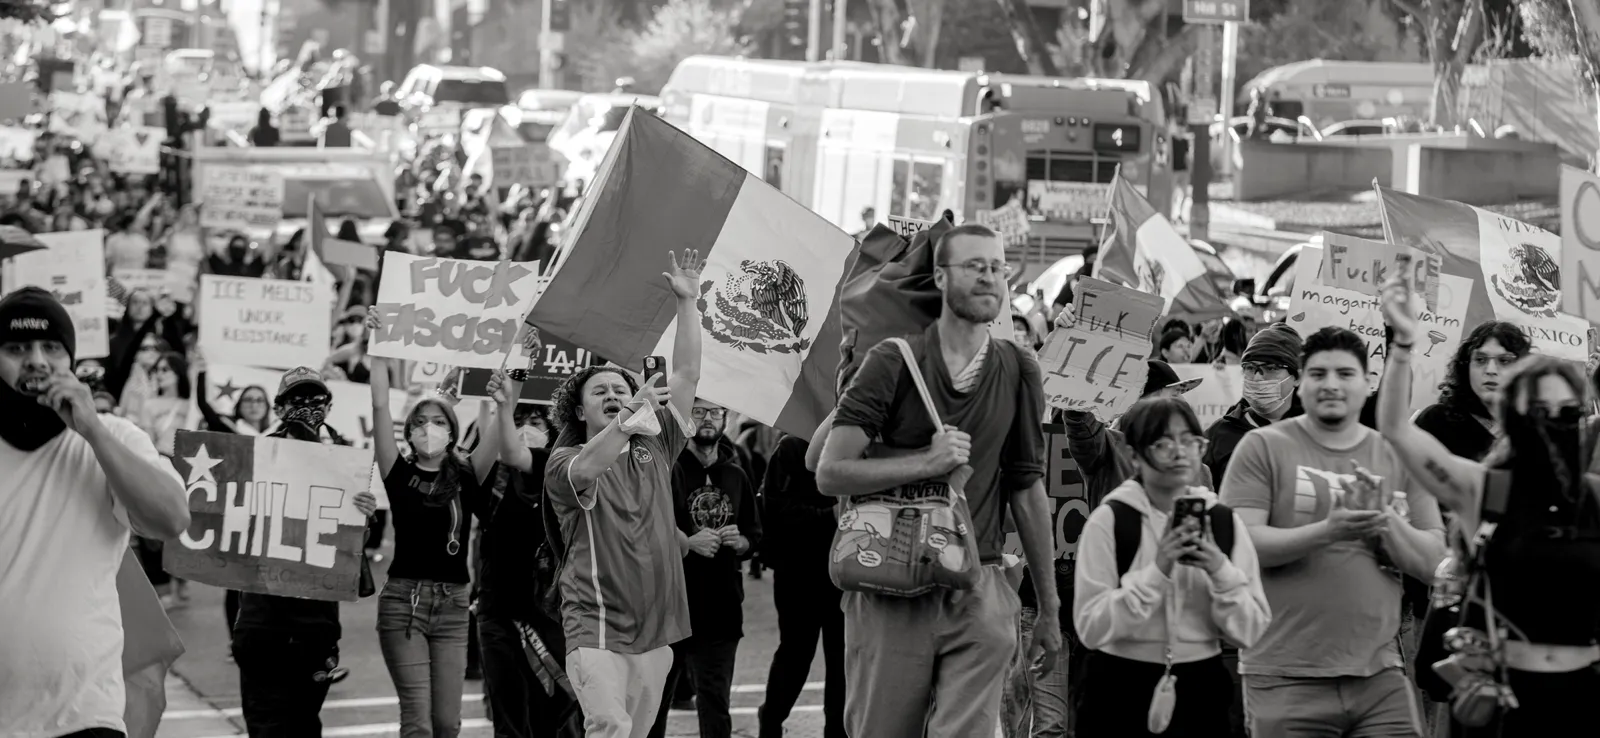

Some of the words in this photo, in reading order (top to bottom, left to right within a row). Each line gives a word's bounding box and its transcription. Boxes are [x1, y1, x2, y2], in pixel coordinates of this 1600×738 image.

[1221, 2, 1237, 17] St
[211, 280, 246, 300] ICE
[261, 283, 315, 304] MELTS
[409, 258, 533, 310] FUCK
[1301, 289, 1383, 316] margarit
[238, 308, 285, 326] UNDER
[223, 327, 308, 347] RESISTANCE
[1349, 318, 1387, 339] becau
[178, 480, 346, 569] CHILE
